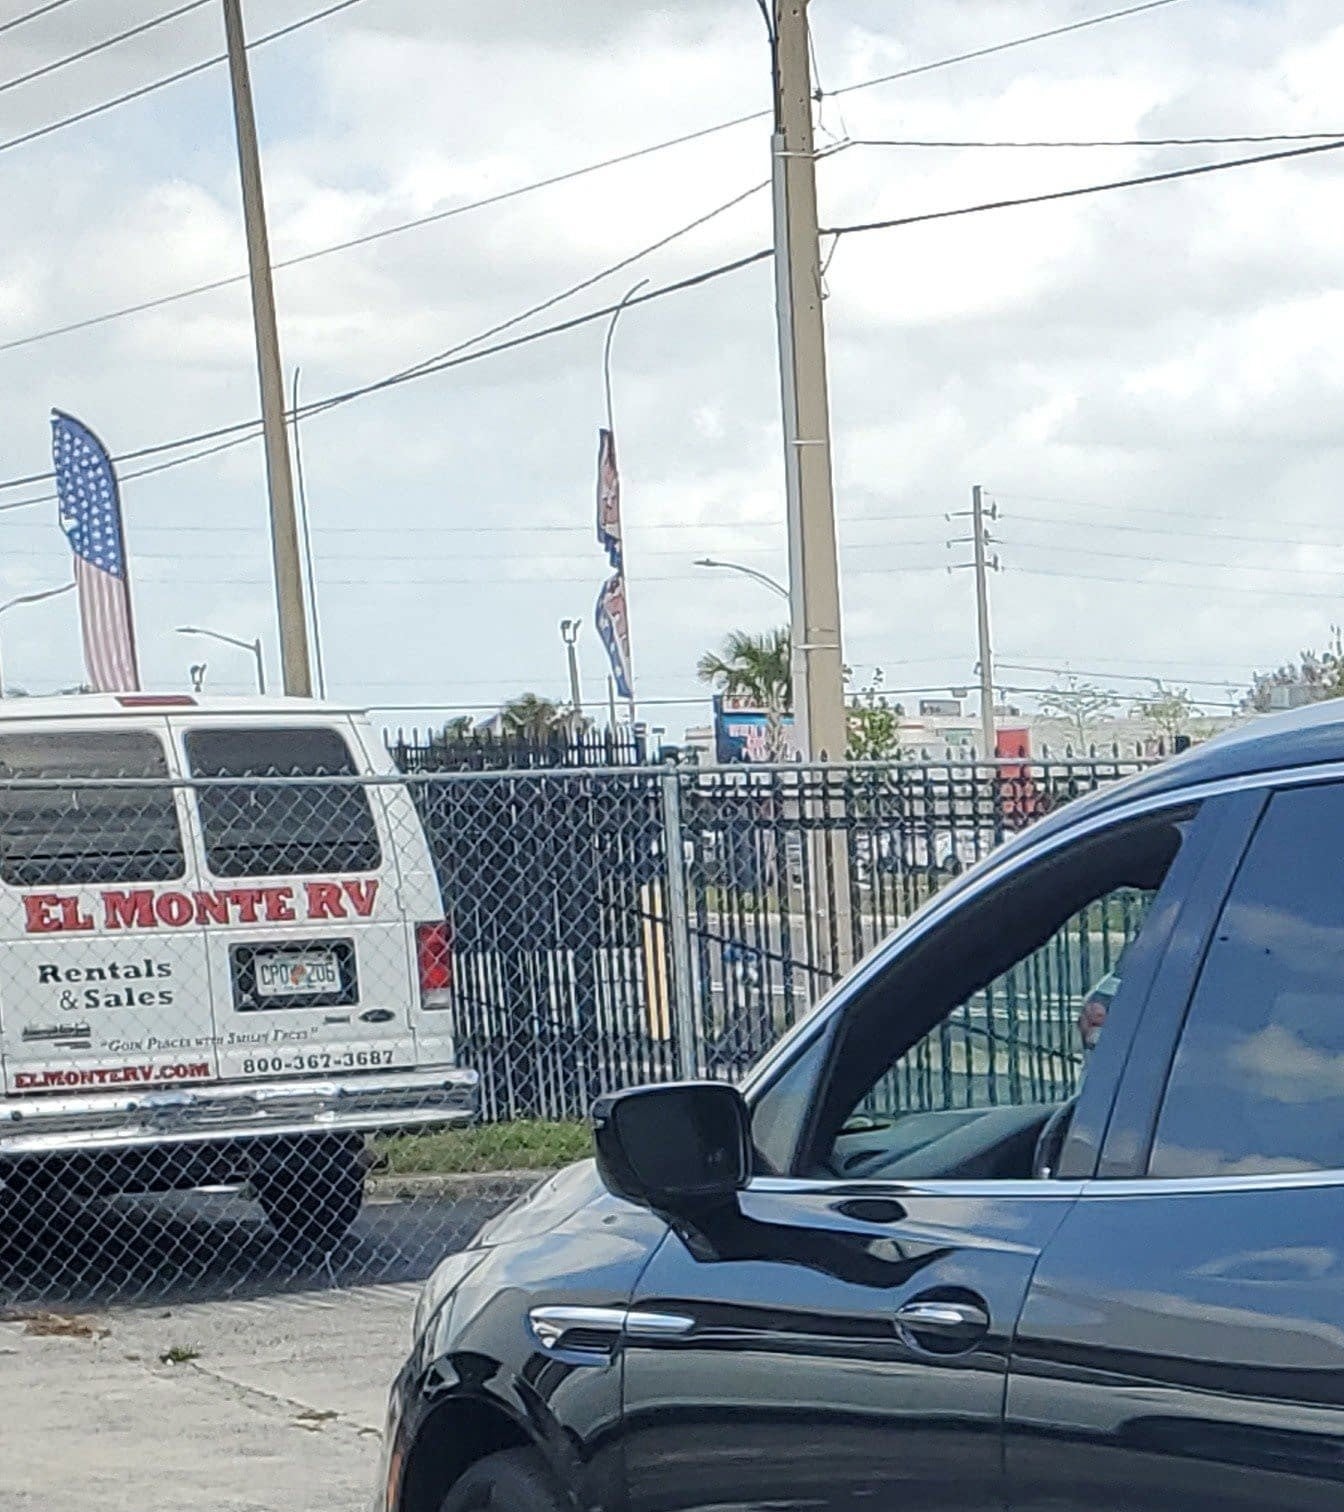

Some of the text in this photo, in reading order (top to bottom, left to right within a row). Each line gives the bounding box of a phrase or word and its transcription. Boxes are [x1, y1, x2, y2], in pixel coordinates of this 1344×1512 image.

[21, 879, 380, 933] EL MONTE RV
[37, 958, 173, 984] Rentals
[60, 987, 174, 1010] & Sales
[243, 1050, 394, 1074] 800-367-3687
[14, 1062, 211, 1089] ELMONTERV.COM
